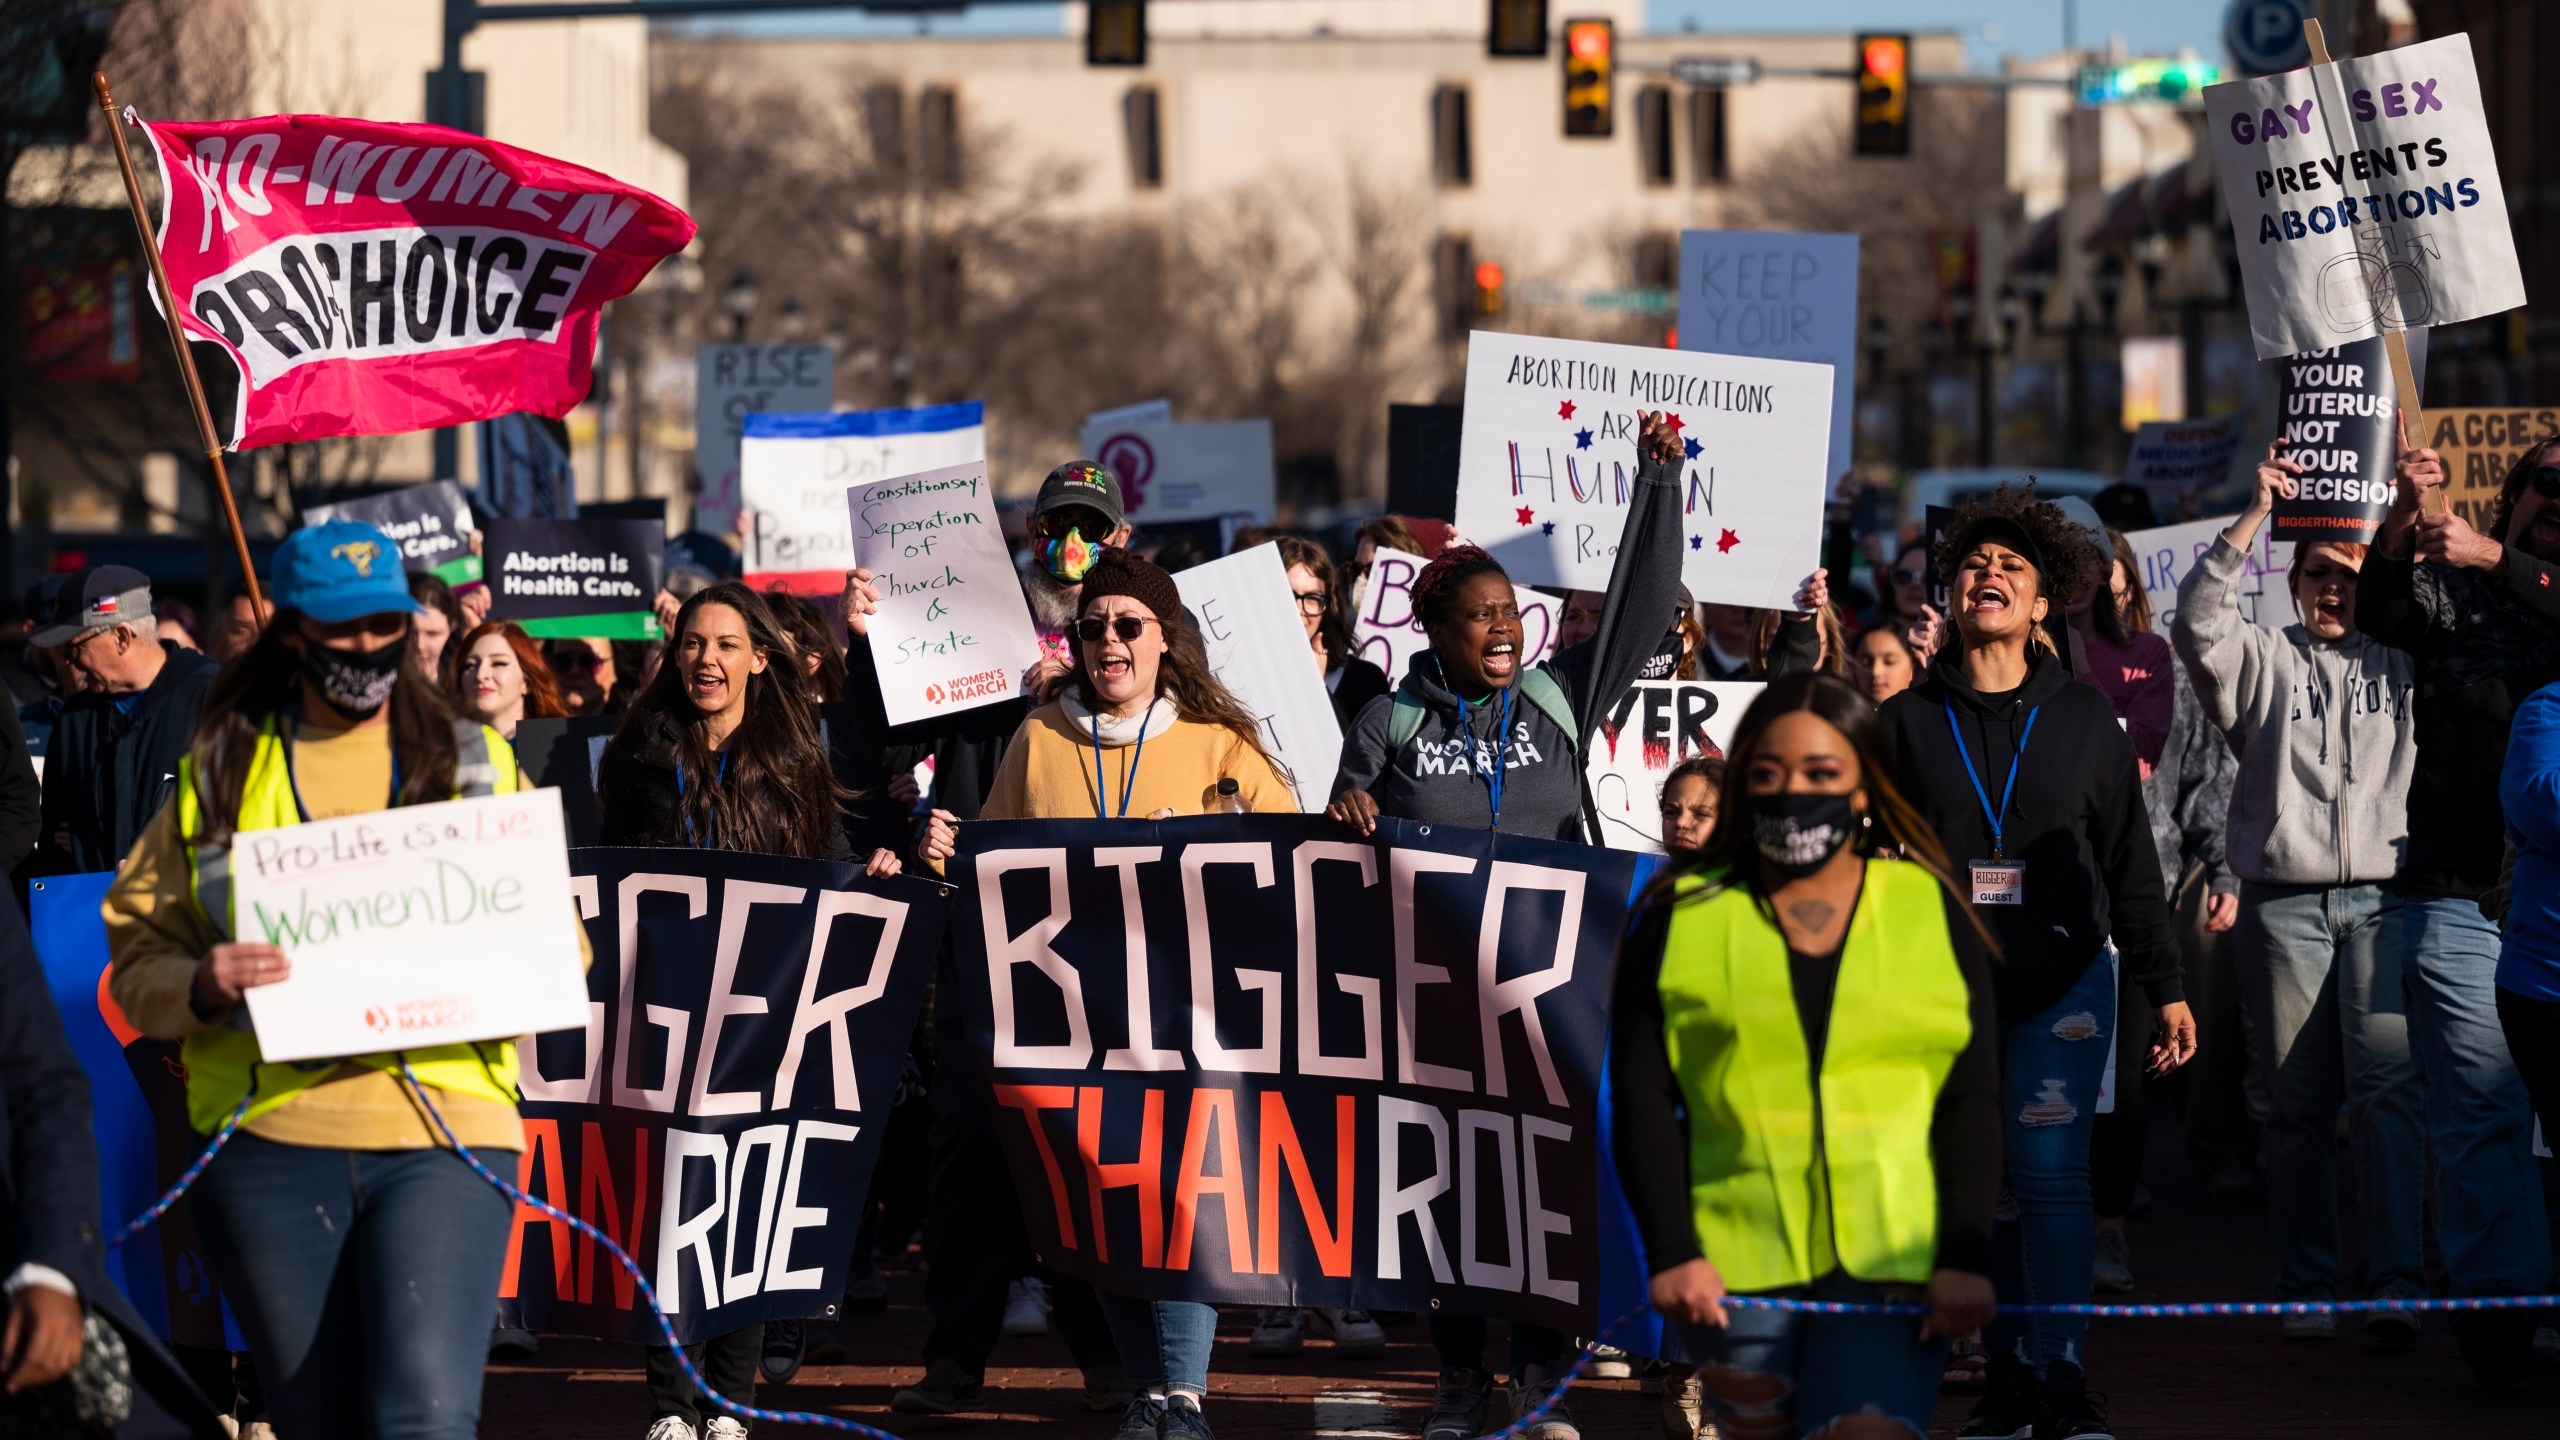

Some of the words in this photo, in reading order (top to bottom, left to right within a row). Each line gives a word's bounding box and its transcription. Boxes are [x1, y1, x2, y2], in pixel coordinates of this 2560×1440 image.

[2230, 99, 2313, 146] GAY
[2352, 78, 2443, 122] SEX
[2256, 138, 2447, 198] PREVENTS
[2259, 178, 2480, 244] ABORTIONS
[1701, 252, 1818, 300] KEEP
[1705, 302, 1815, 349] YOUR
[714, 345, 821, 388] RISE
[2290, 363, 2364, 388] YOUR
[1507, 355, 1616, 393] ABORTION
[1630, 369, 1774, 414] MEDICATIONS
[2287, 392, 2393, 419] UTERUS
[1600, 410, 1638, 448] AR
[2285, 420, 2340, 444] NOT
[2283, 449, 2359, 473] YOUR
[1508, 441, 1714, 518] HUMN
[421, 512, 441, 533] is
[859, 503, 982, 549] Seperation
[404, 534, 458, 558] Care.
[503, 551, 606, 573] Abortion
[610, 552, 629, 573] is
[904, 536, 937, 558] of
[504, 575, 579, 597] Health
[583, 576, 641, 597] Care.
[870, 567, 965, 601] Church
[927, 598, 949, 621] &
[895, 631, 979, 664] State
[948, 668, 1004, 690] WOMEN'S
[951, 679, 1008, 703] MARCH
[2350, 677, 2412, 722] YORK
[1416, 742, 1543, 777] MARCH
[253, 825, 390, 877] Pro-Life
[403, 820, 438, 850] is
[447, 825, 467, 841] a
[475, 809, 532, 842] Lie
[1976, 871, 2007, 885] BIGGER
[1980, 893, 2014, 902] GUEST
[976, 840, 1587, 1108] BIGGER
[398, 1010, 477, 1031] MARCH
[993, 1083, 1356, 1278] THAN
[1377, 1094, 1580, 1306] ROE
[655, 1119, 861, 1314] ROE
